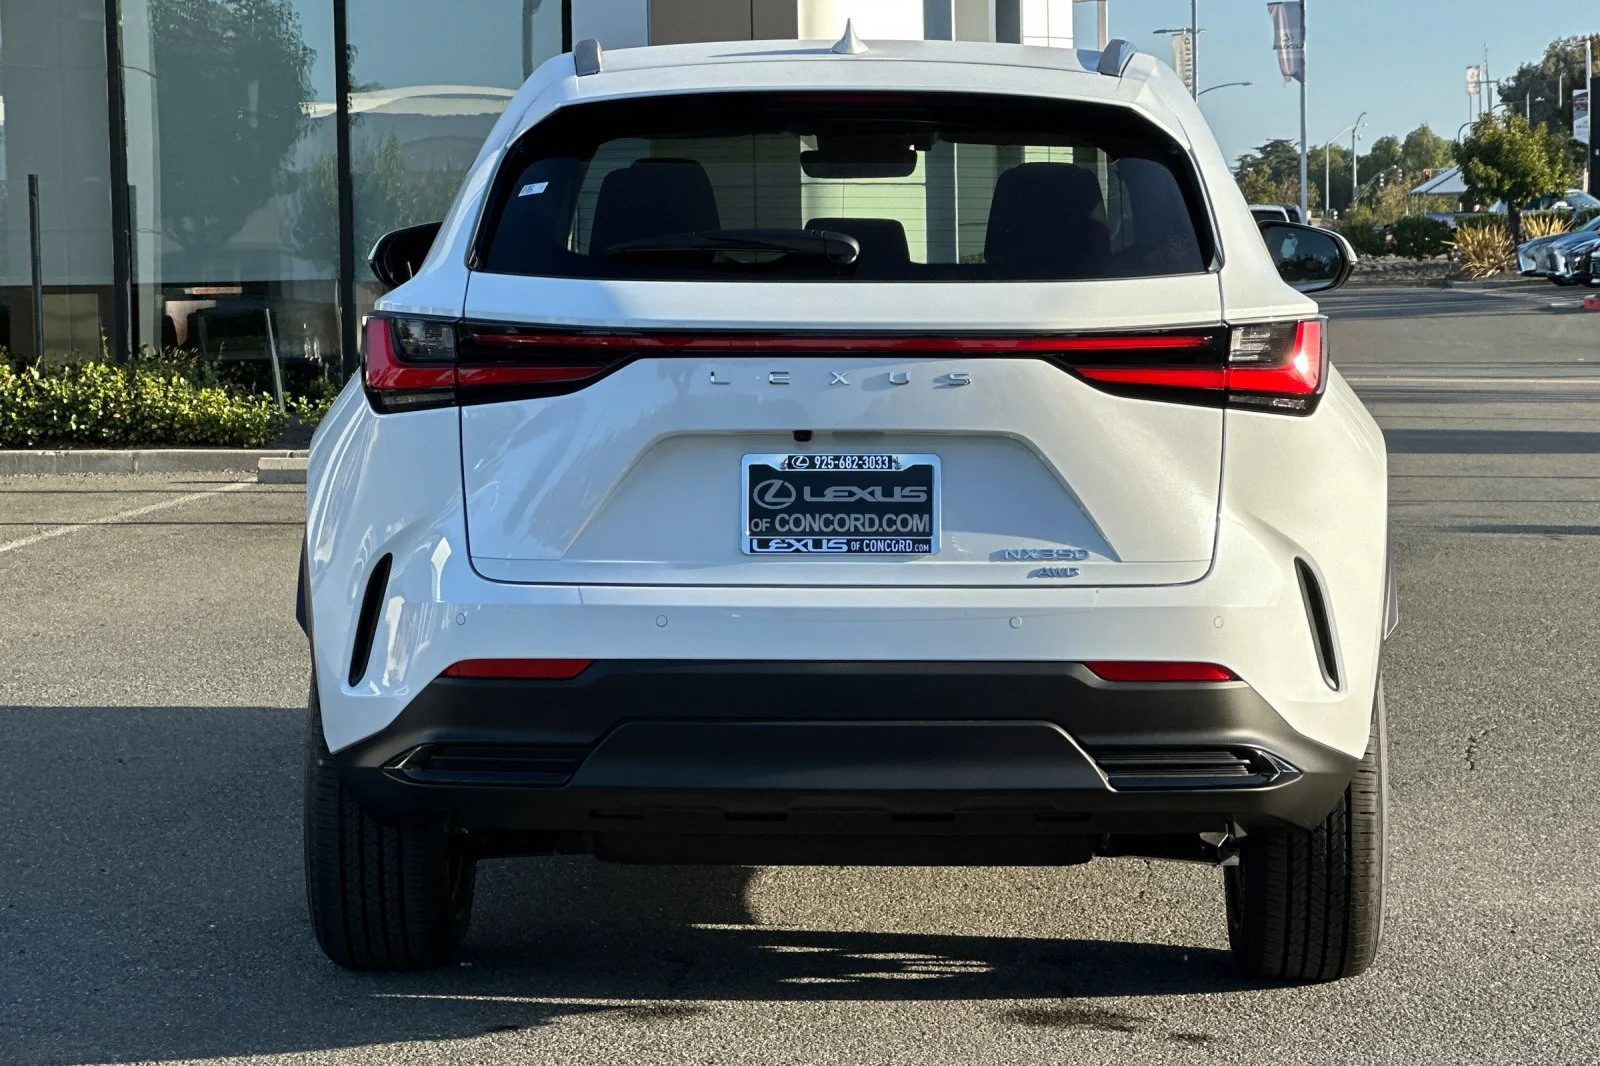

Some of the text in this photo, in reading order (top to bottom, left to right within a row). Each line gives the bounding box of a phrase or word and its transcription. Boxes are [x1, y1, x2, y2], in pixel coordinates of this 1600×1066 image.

[710, 371, 971, 386] LEXUS
[814, 455, 889, 469] 925-682-3033
[803, 486, 928, 502] LEXUS
[750, 513, 930, 533] OF CONCORD.COM
[752, 538, 848, 552] LEXUS
[851, 541, 861, 551] OF
[1039, 567, 1080, 578] AWD
